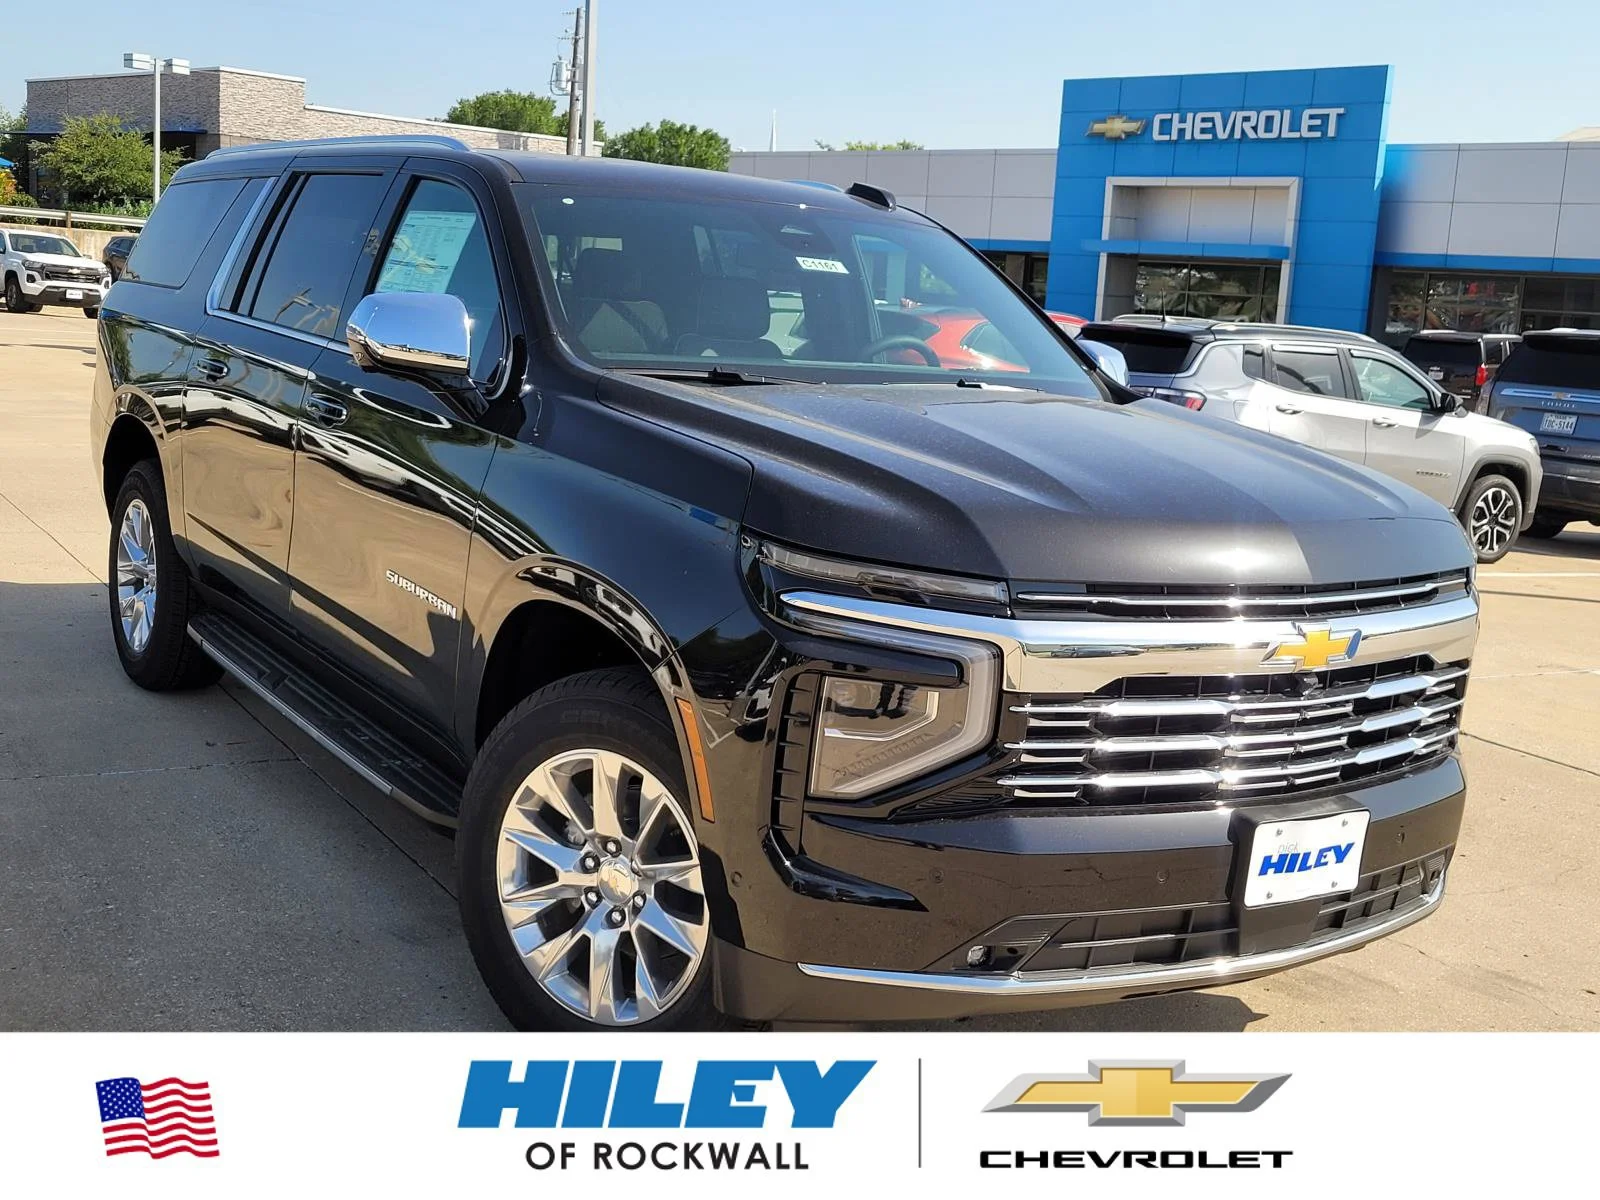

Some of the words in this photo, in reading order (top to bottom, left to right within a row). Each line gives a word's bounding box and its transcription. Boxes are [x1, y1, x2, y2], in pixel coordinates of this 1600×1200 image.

[1151, 106, 1346, 142] CHEVROLET
[385, 569, 458, 620] SUBURBAN
[1258, 842, 1355, 876] HILEY
